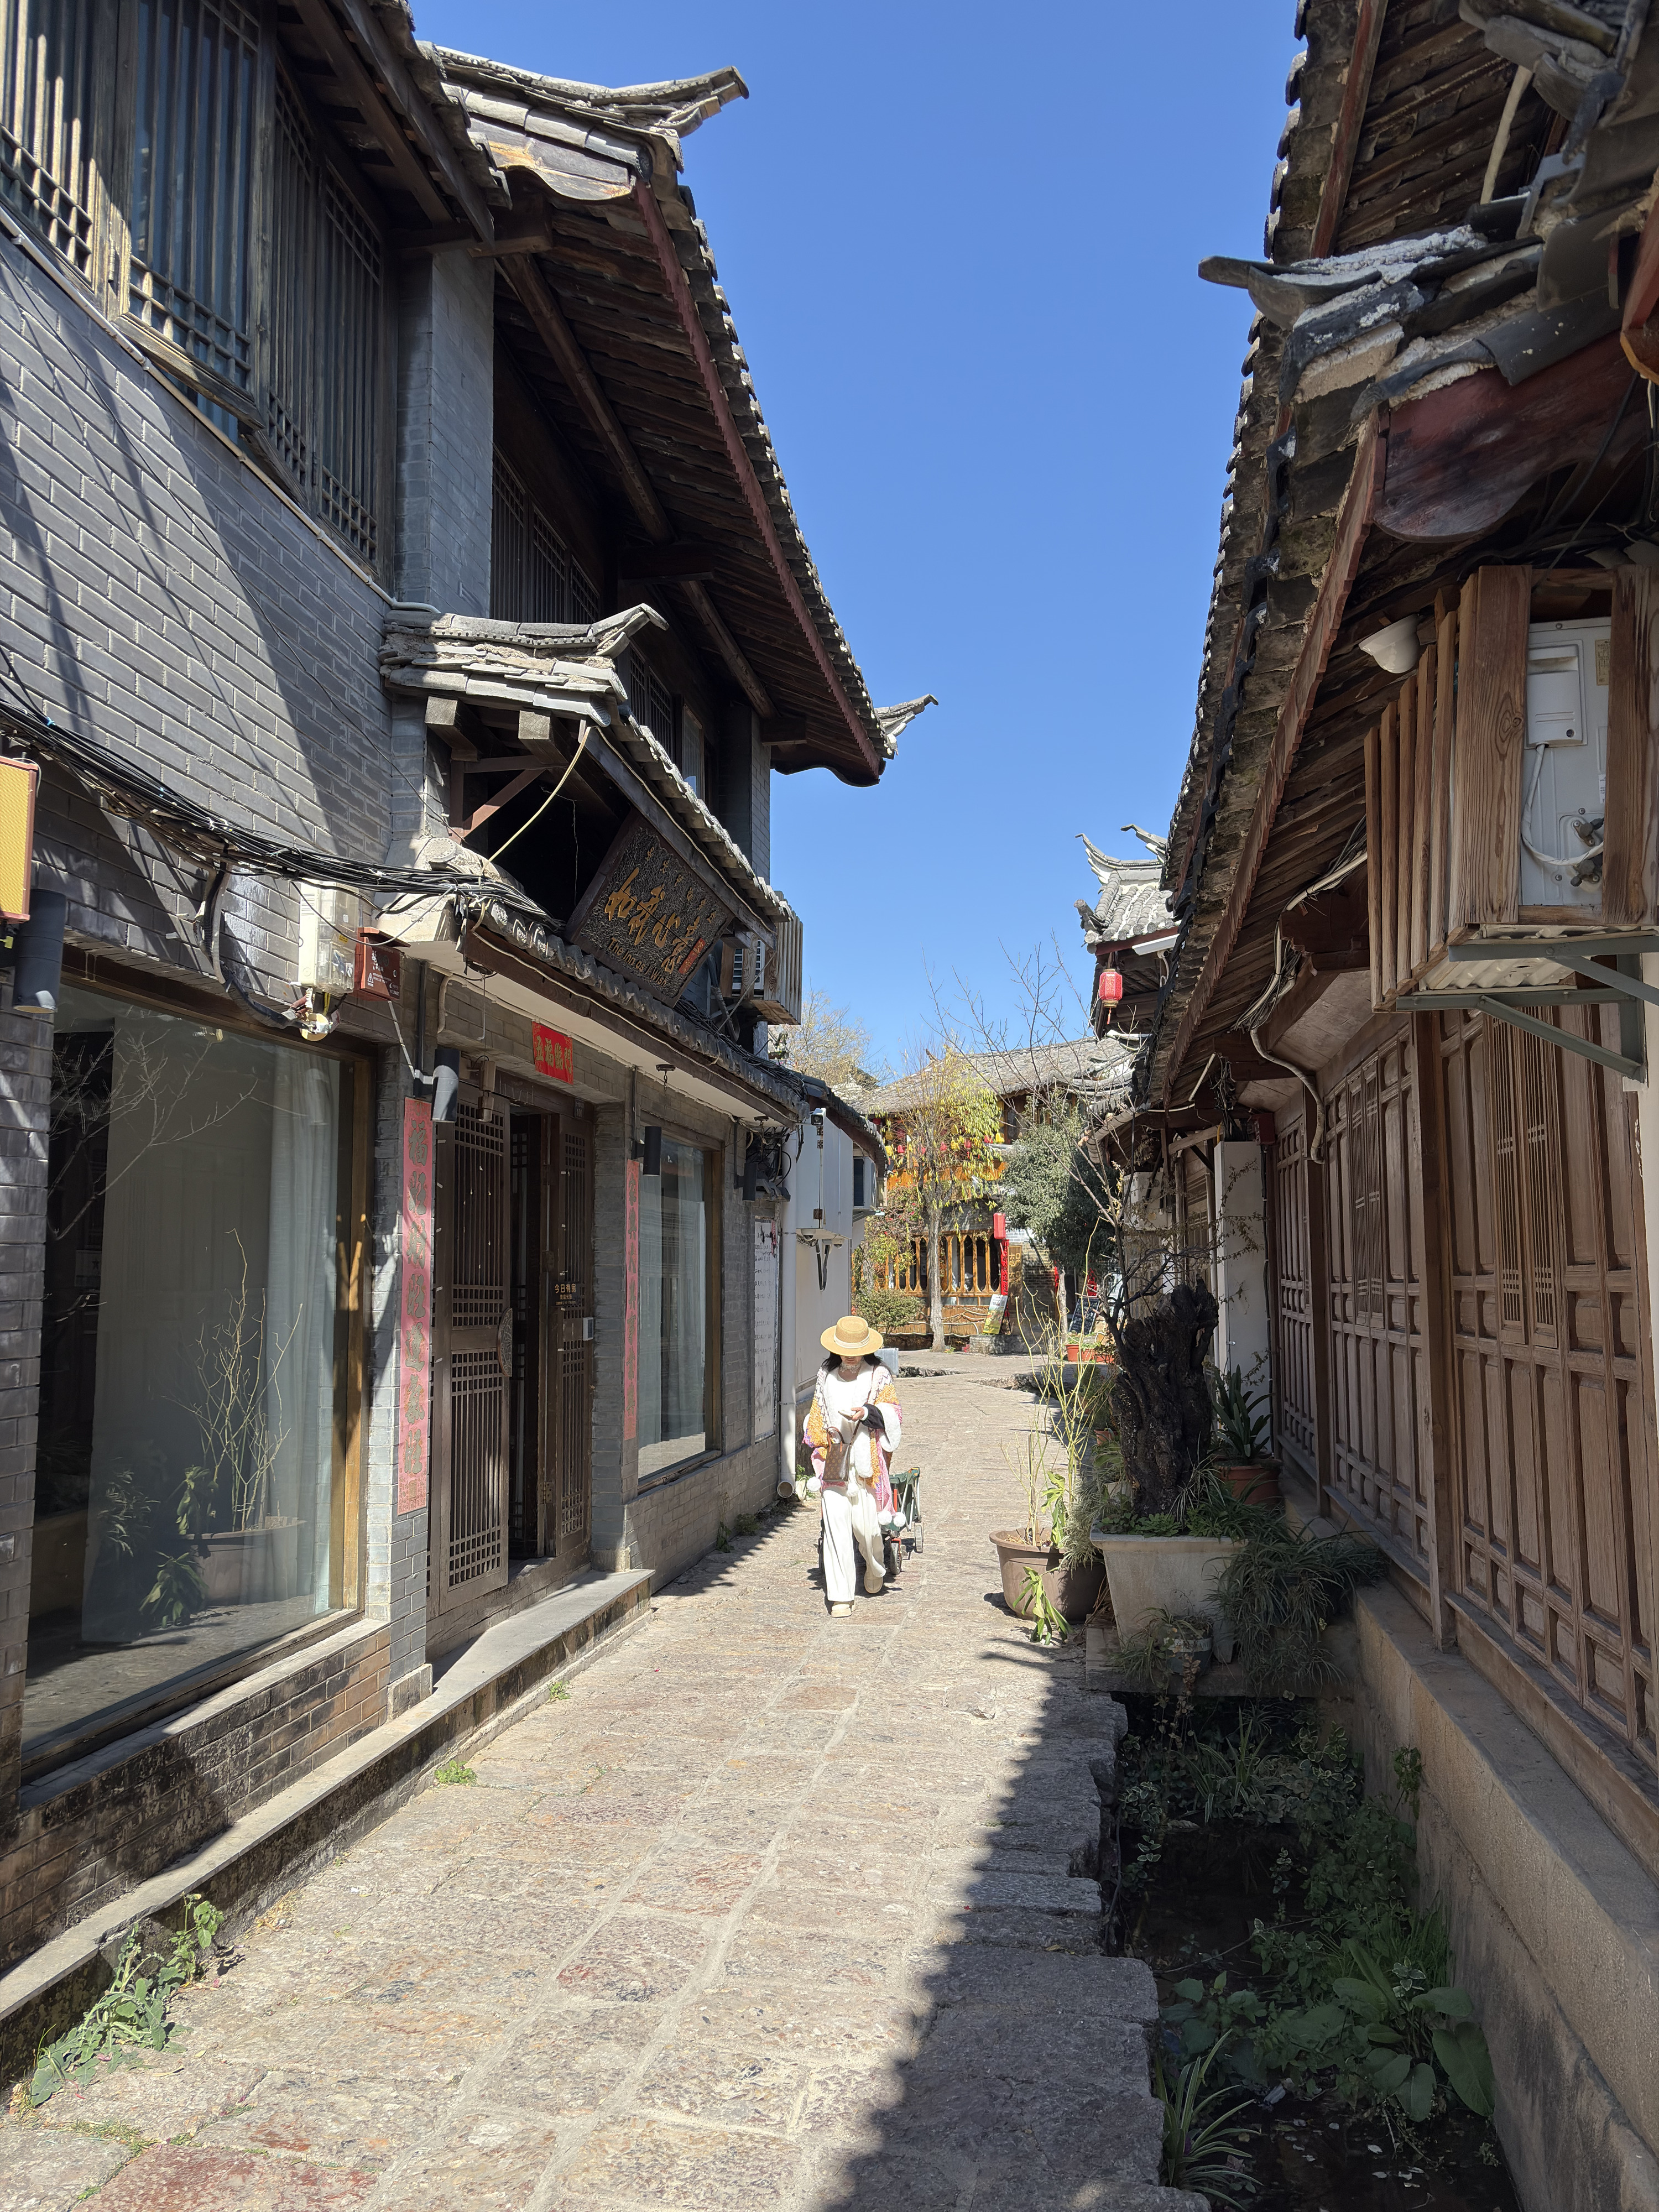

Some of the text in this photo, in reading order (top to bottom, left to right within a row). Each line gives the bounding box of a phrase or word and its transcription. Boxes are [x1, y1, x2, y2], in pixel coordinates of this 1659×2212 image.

[608, 937, 623, 956] The
[623, 951, 636, 966] Inn
[636, 961, 645, 972] as
[650, 967, 667, 987] Wish
[555, 1284, 576, 1293] 今日有房
